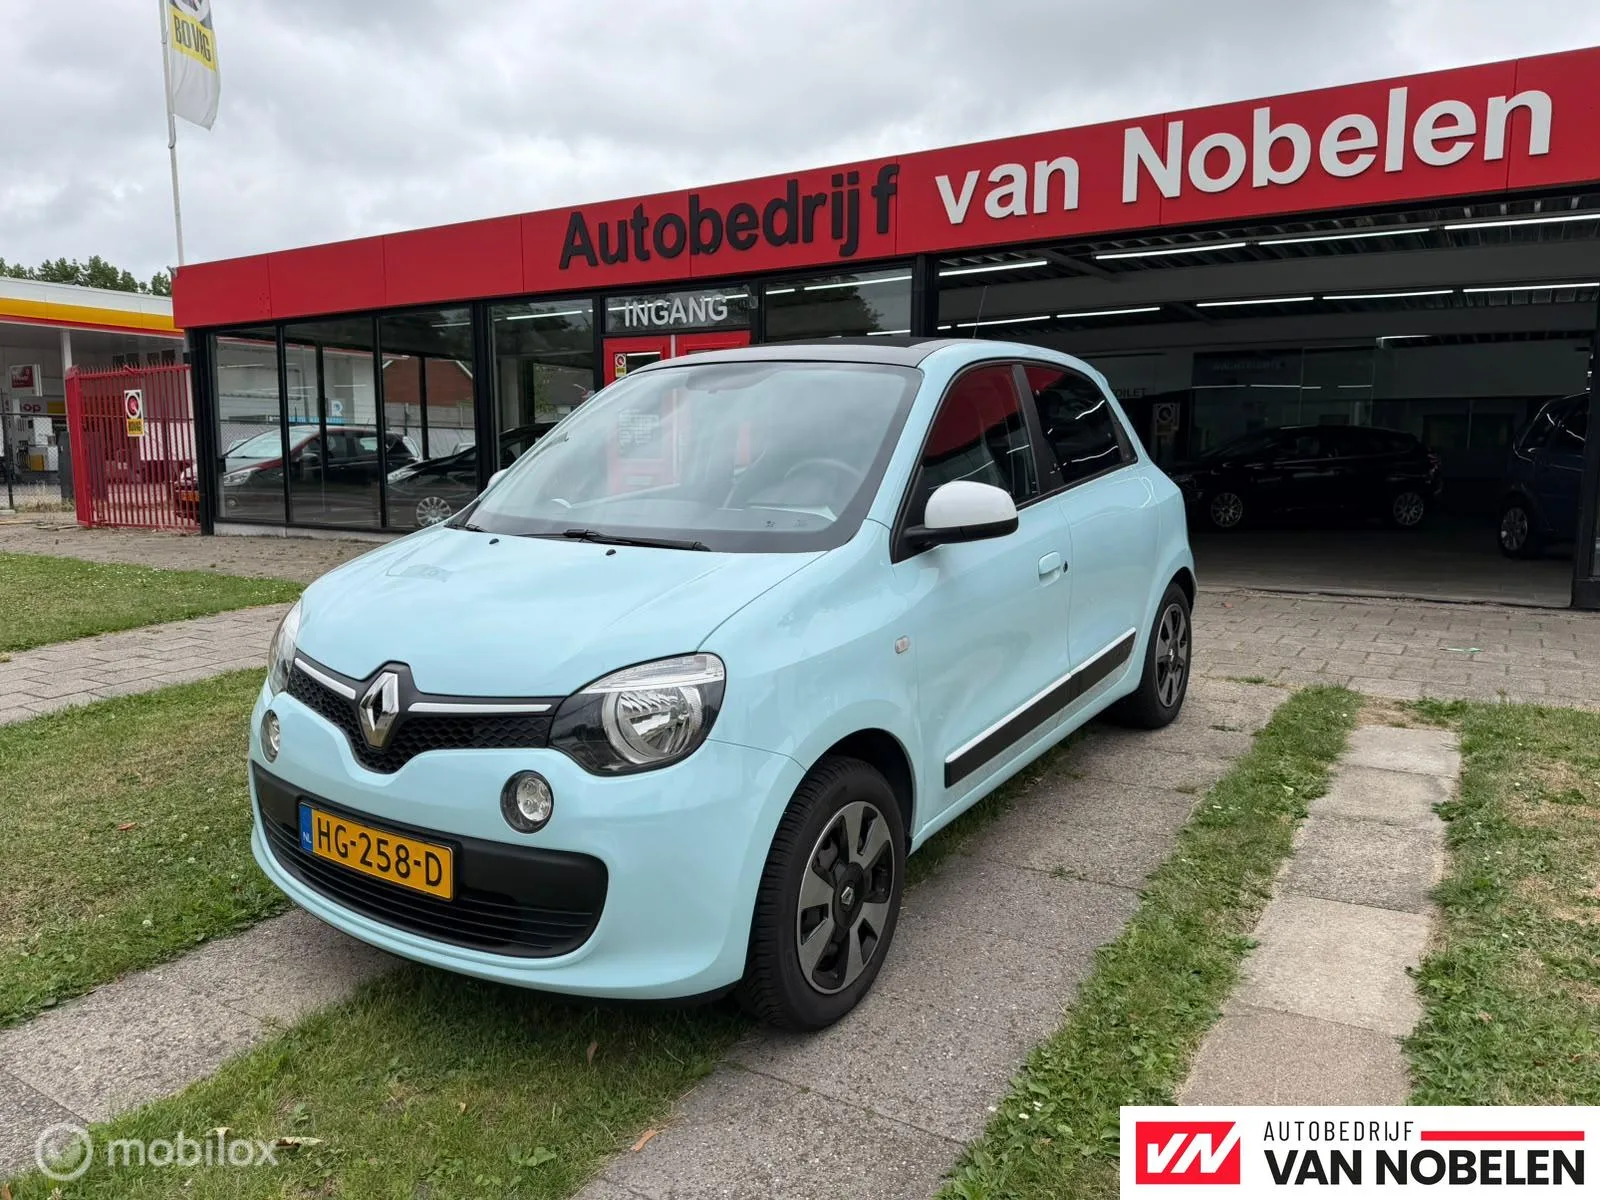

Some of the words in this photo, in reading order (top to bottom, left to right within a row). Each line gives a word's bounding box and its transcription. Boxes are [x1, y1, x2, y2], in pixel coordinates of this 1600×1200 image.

[559, 164, 900, 270] Autobedrijf
[935, 156, 1080, 225] van
[1122, 87, 1553, 204] Nobelen
[624, 294, 728, 327] INGANG
[302, 831, 312, 844] NL
[317, 816, 443, 887] HG-258-D
